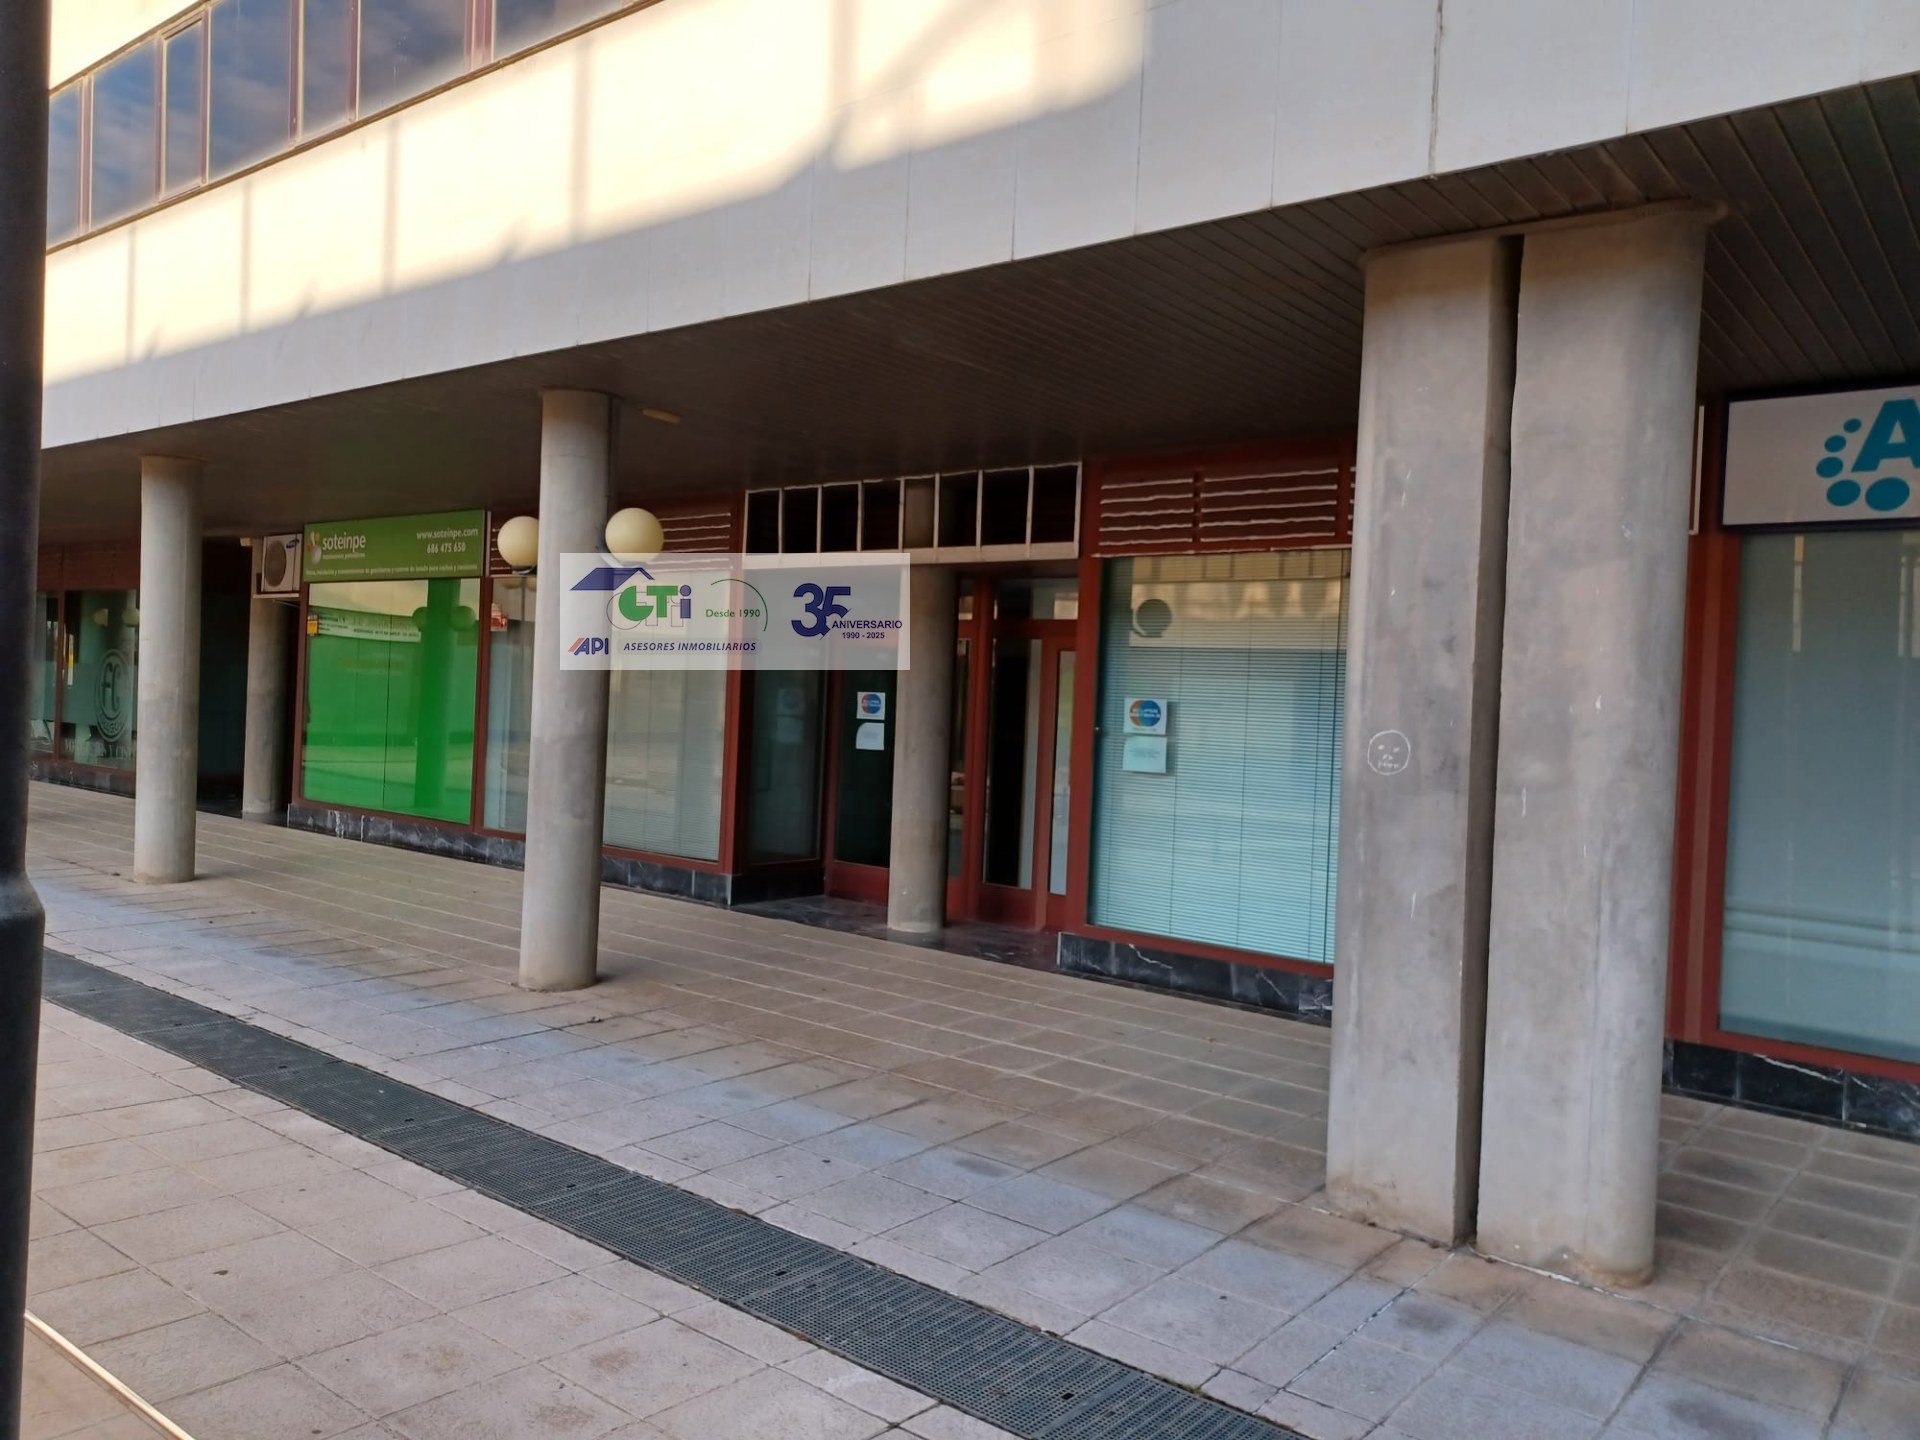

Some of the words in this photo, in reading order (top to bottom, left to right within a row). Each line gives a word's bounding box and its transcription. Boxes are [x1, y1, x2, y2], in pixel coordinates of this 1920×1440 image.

[417, 527, 478, 540] www.soteinpe.com
[322, 531, 366, 552] soteinpe
[427, 543, 438, 554] 686
[440, 542, 452, 553] 475
[454, 541, 466, 552] 650
